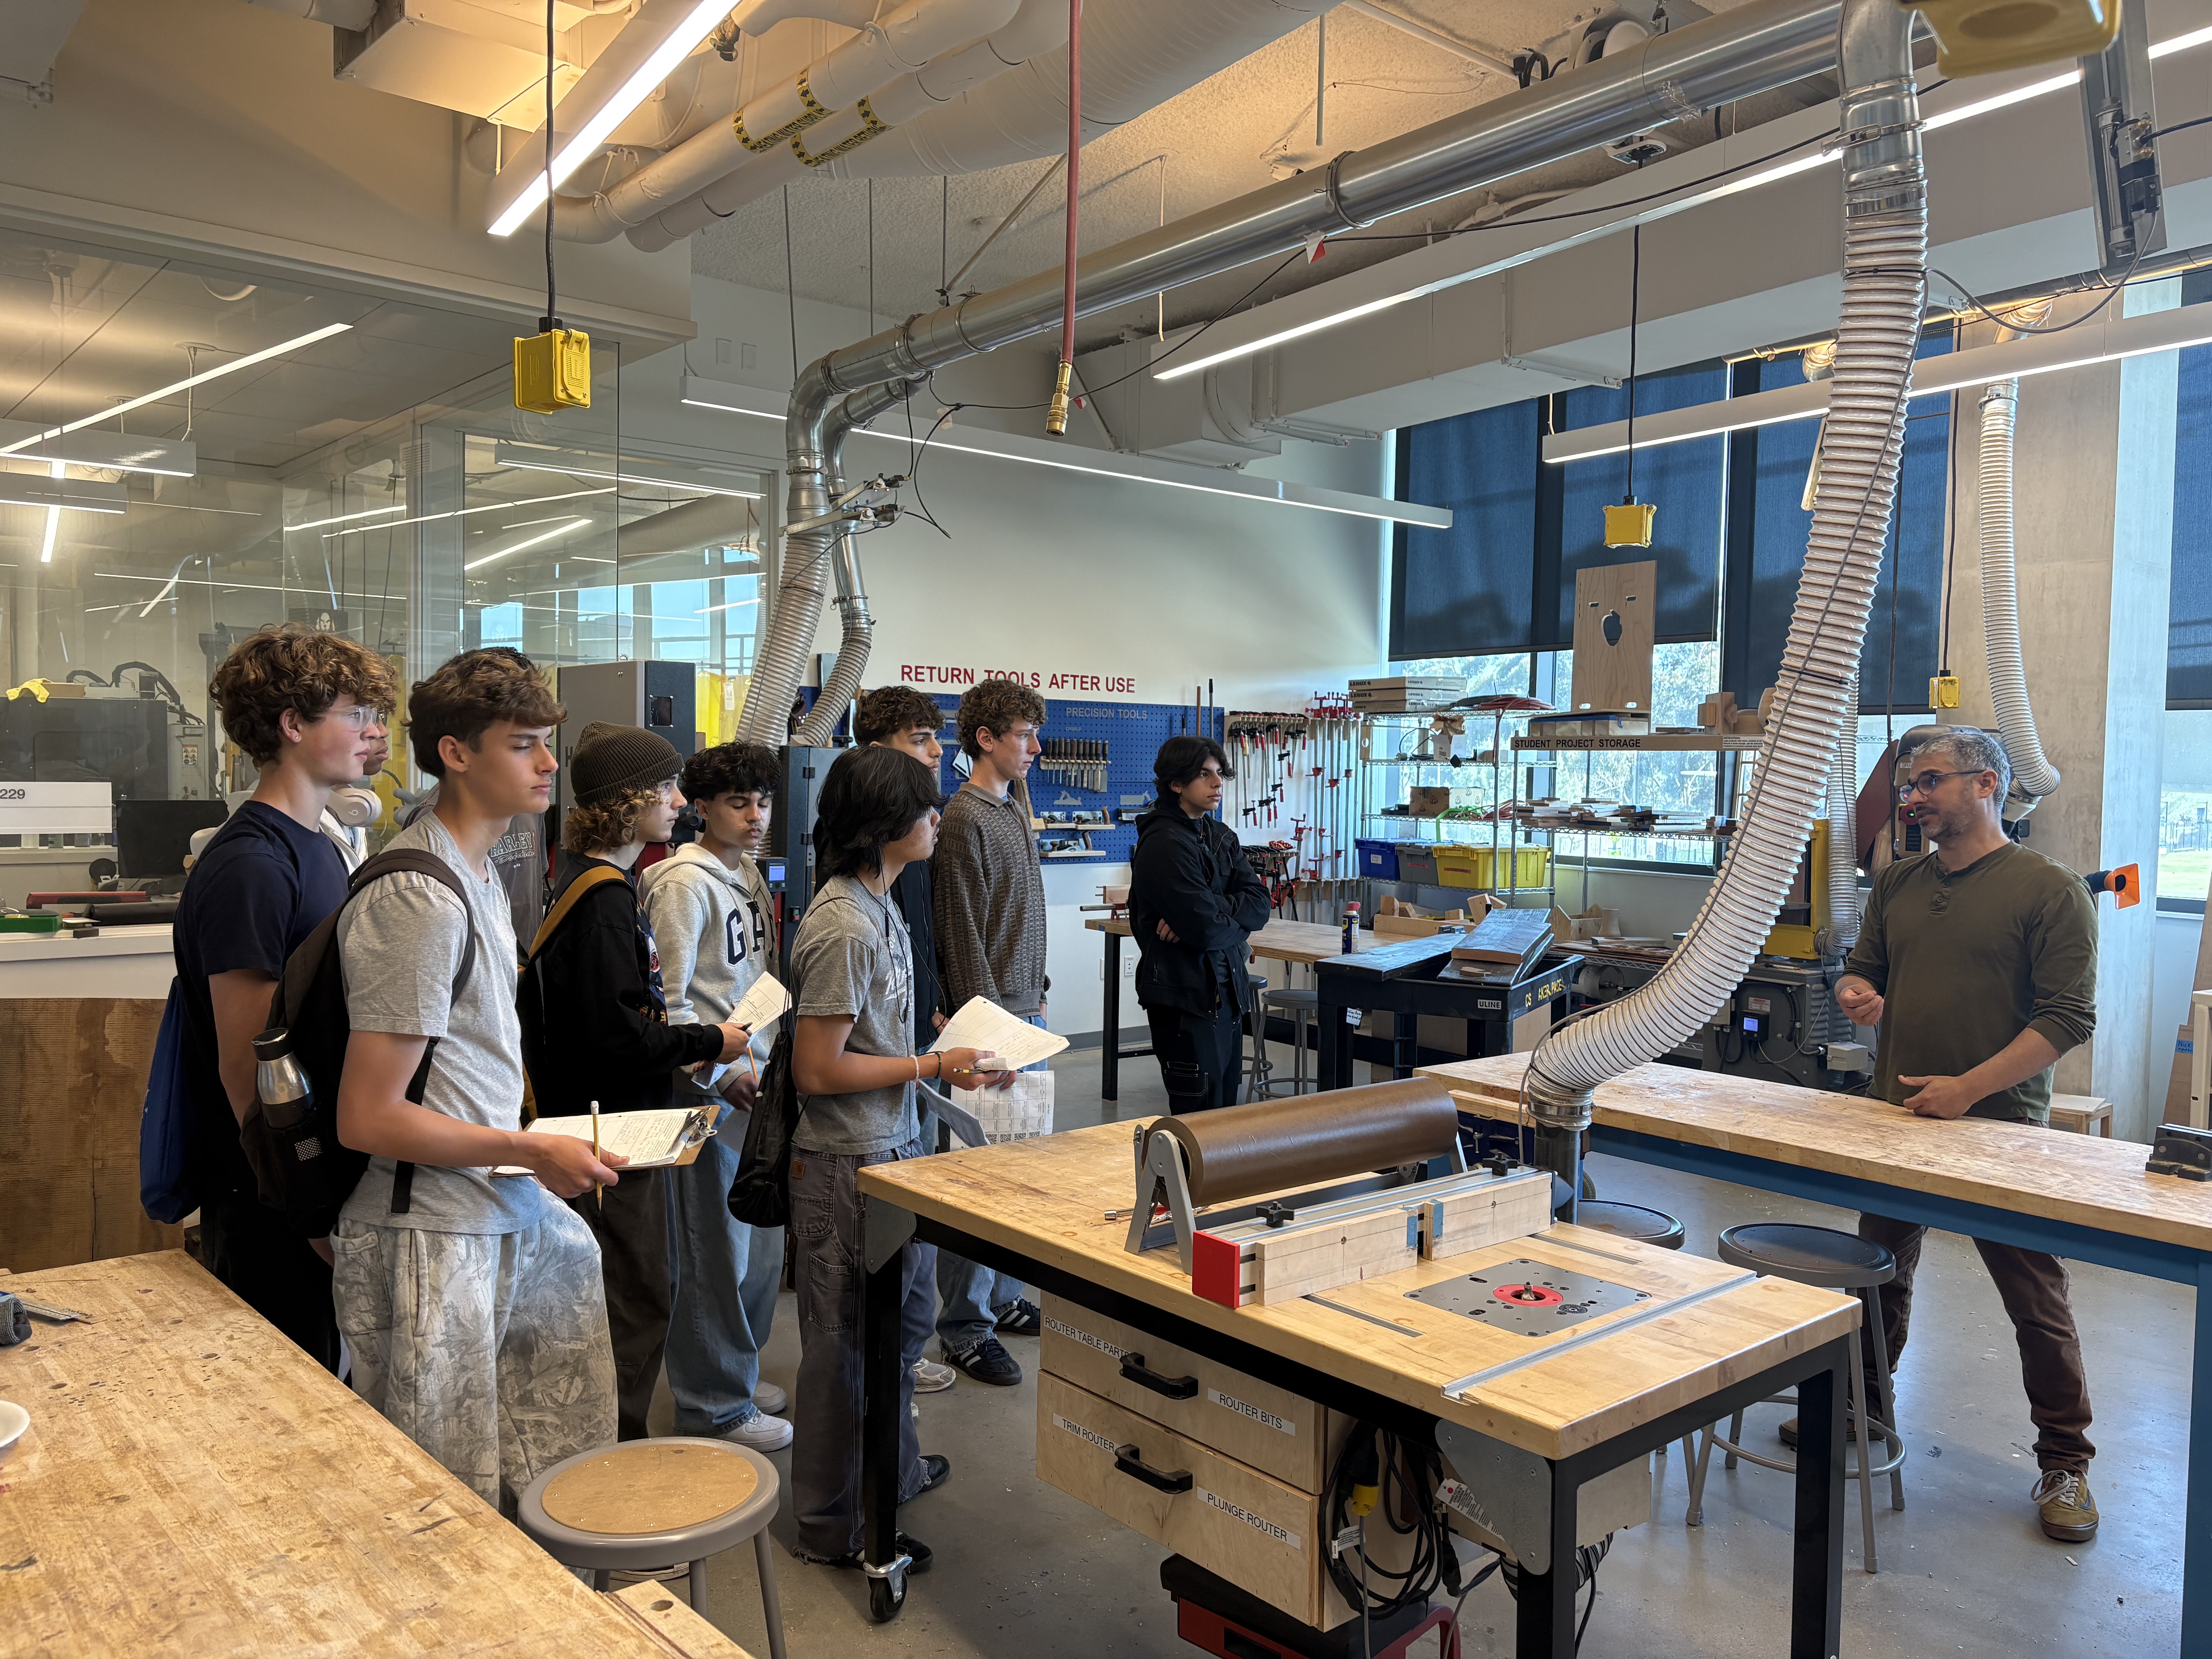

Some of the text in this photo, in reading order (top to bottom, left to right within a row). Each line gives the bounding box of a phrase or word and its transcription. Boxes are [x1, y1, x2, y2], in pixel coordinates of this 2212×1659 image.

[901, 665, 974, 684] RETURN
[1048, 673, 1101, 691] AFTER
[1106, 677, 1135, 693] USE
[1066, 707, 1147, 719] PRECISION TOOLS
[1515, 739, 1641, 748] STUDENT PROJECT STORAGE
[0, 788, 26, 800] 229
[491, 832, 532, 857] HARLEY
[1525, 992, 1532, 1007] CS
[1045, 1317, 1075, 1338] ROUTER
[1077, 1331, 1101, 1350] TABLE
[1220, 1393, 1282, 1429] ROUTER BITS
[1062, 1419, 1115, 1453] TRIM ROUTER
[1207, 1493, 1287, 1542] PLUNGE ROUTER
